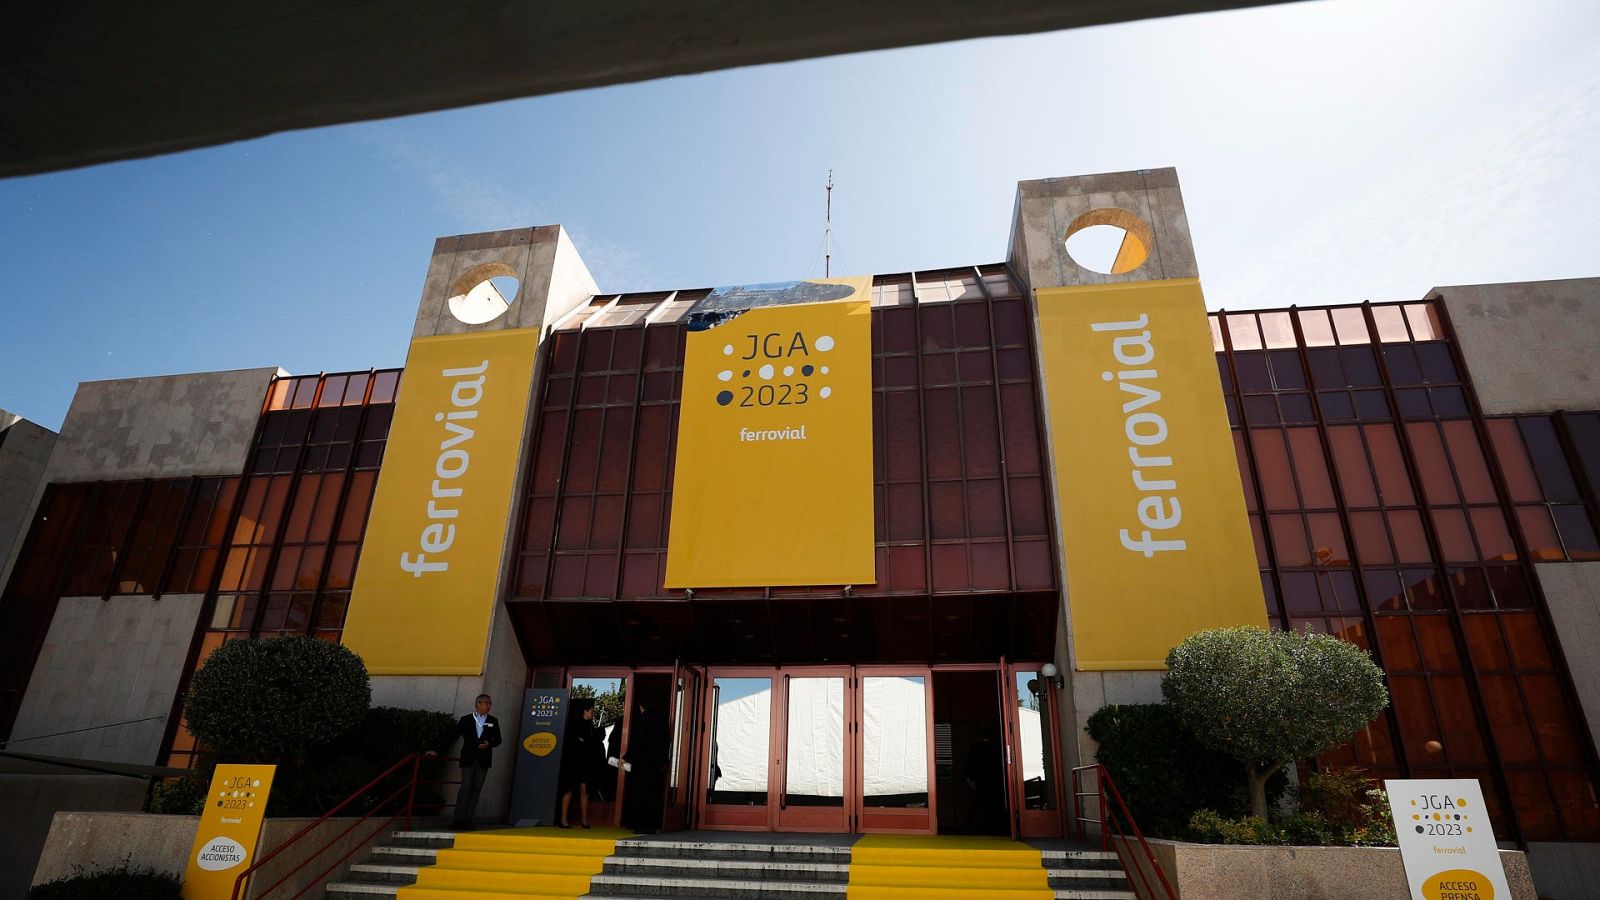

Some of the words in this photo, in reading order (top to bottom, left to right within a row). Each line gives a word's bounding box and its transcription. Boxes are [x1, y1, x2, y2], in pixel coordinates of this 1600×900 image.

[742, 331, 809, 360] JGA
[739, 383, 809, 407] 2023
[740, 424, 806, 442] ferrovial
[1090, 313, 1187, 558] ferrovial
[400, 359, 489, 577] ferrovial
[537, 695, 554, 704] JGA
[536, 709, 553, 717] 2023
[229, 777, 251, 789] JGA
[223, 799, 247, 810] 2023
[1420, 795, 1456, 810] JGA
[1426, 823, 1463, 836] 2023
[210, 845, 235, 853] ACCESO
[1433, 846, 1467, 854] ferrovial
[200, 853, 241, 862] ACCIONISTAS
[1439, 881, 1477, 891] ACCESO
